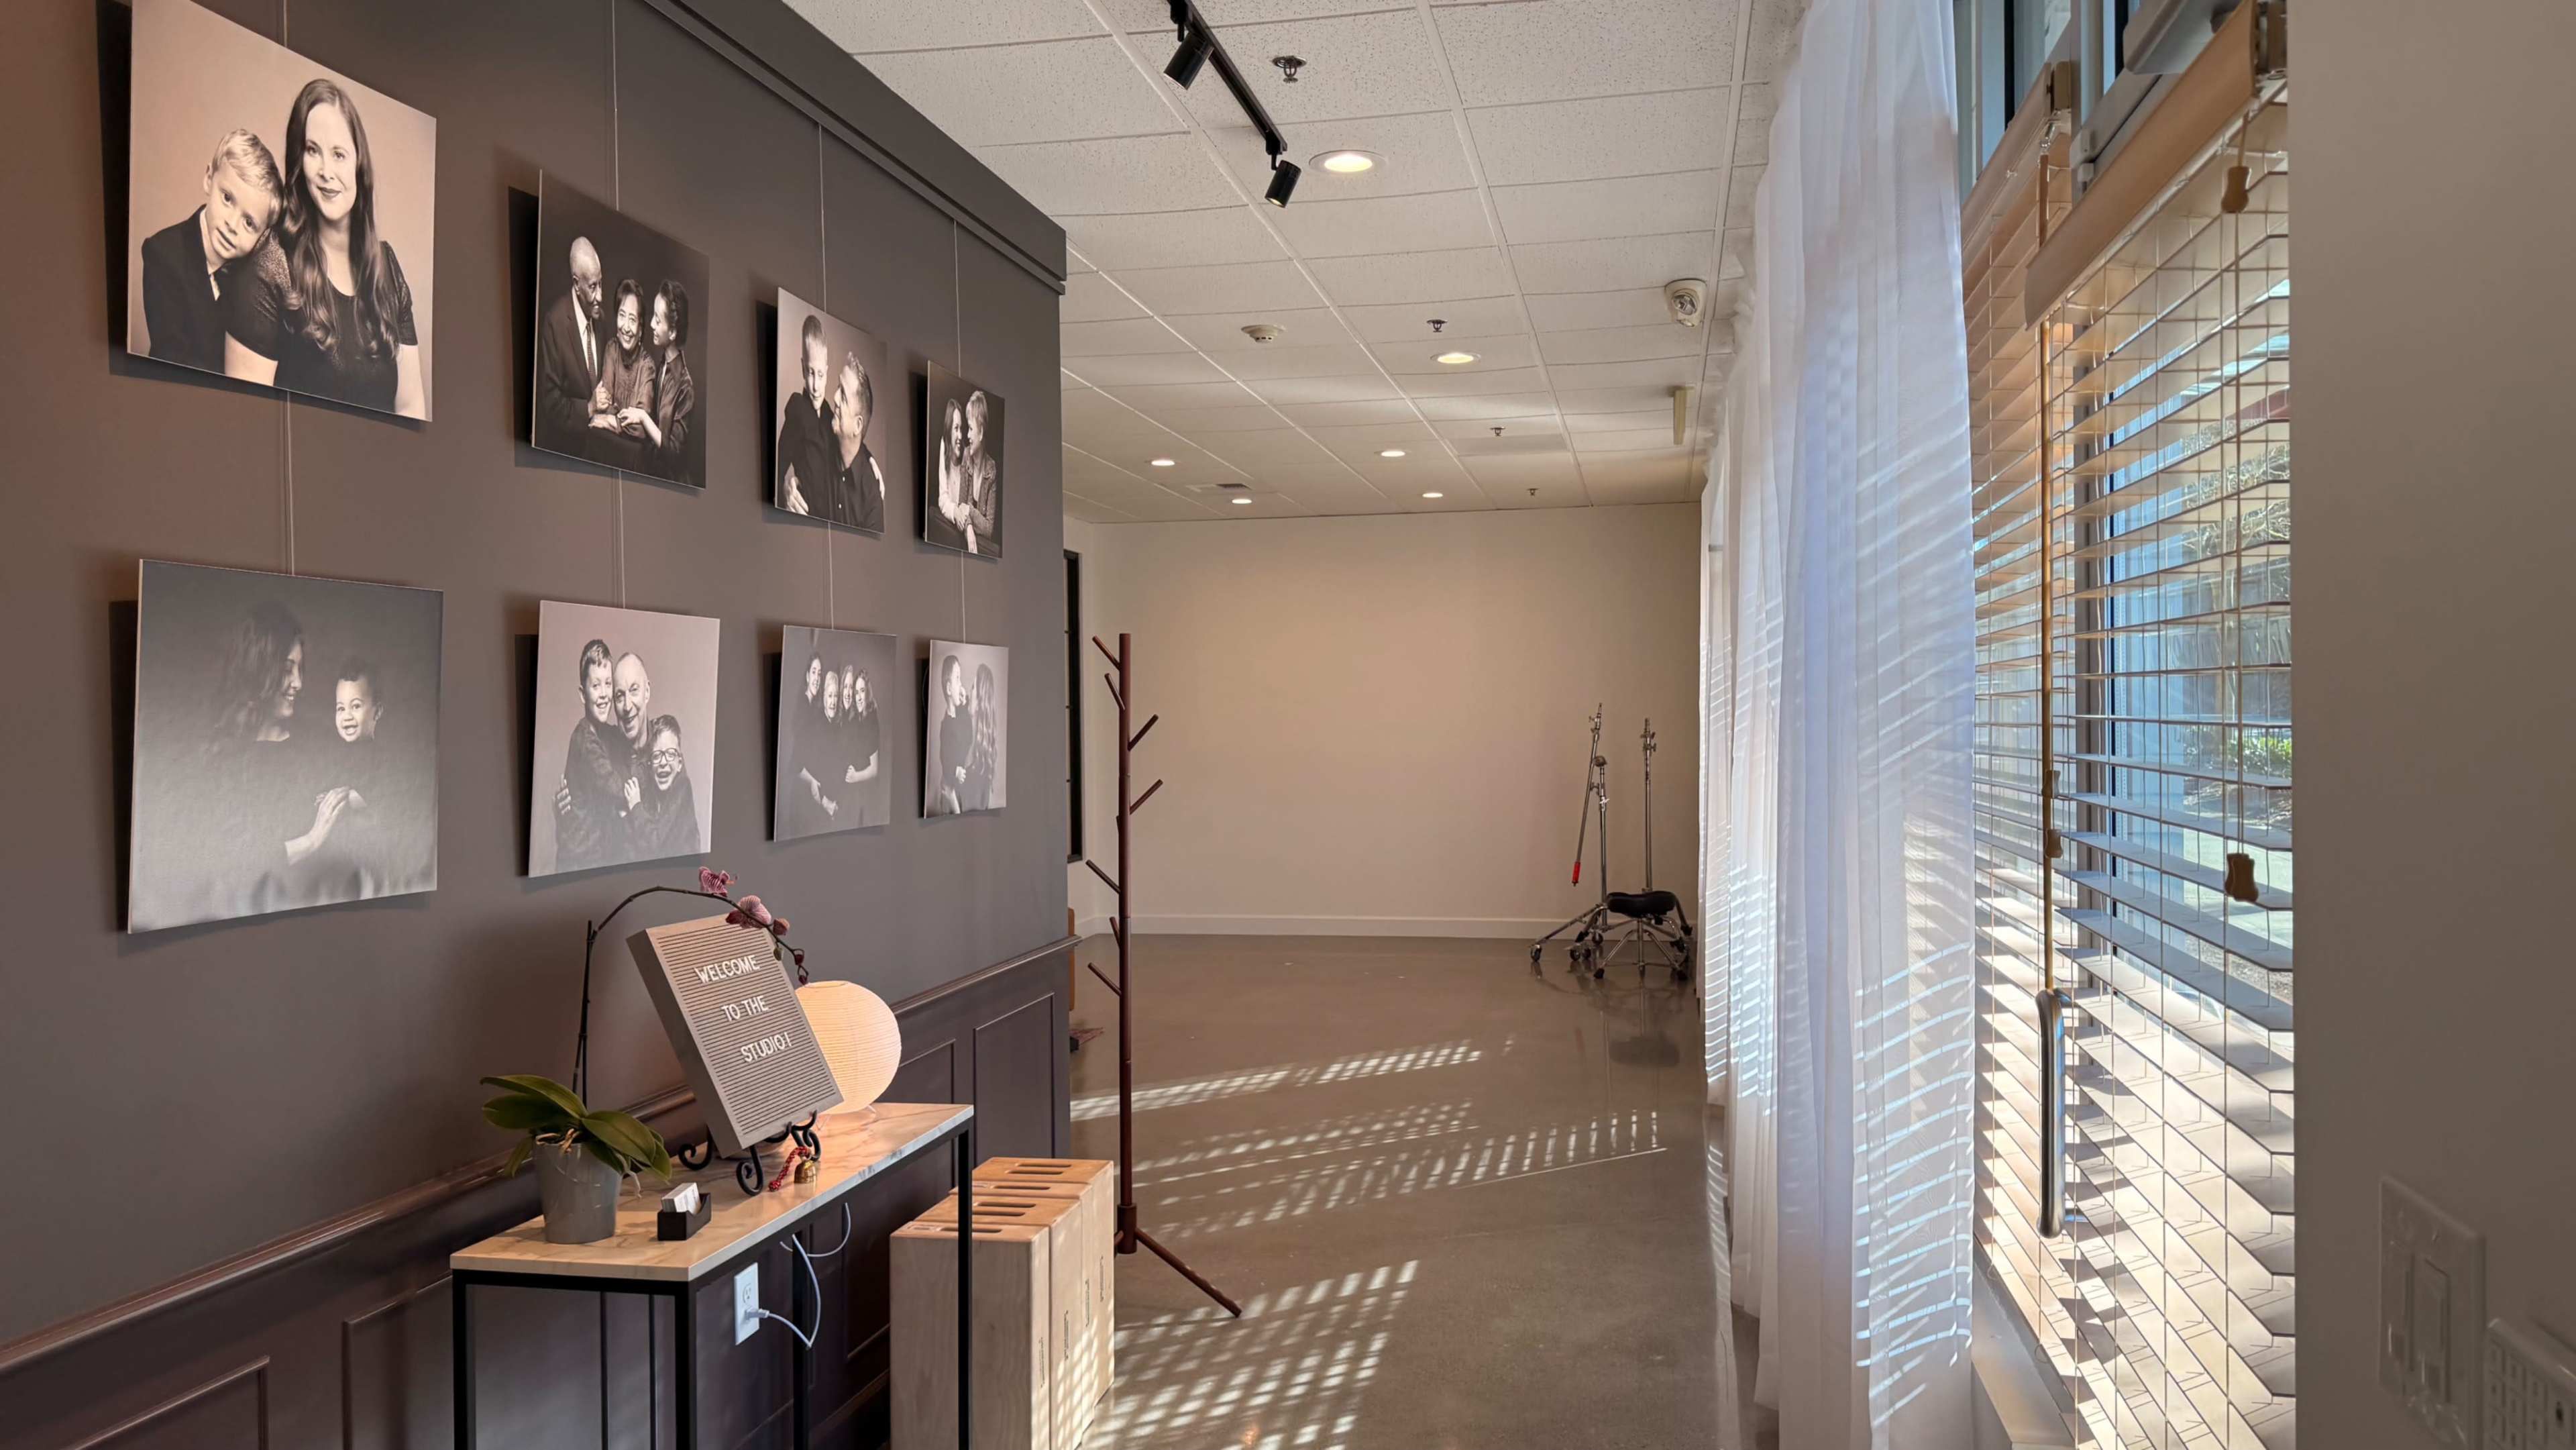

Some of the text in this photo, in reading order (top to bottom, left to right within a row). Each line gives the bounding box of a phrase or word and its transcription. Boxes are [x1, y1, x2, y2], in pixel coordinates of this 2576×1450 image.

[694, 955, 760, 983] WELCOME
[720, 996, 769, 1021] TO THE
[741, 1032, 792, 1062] STUDIO!
